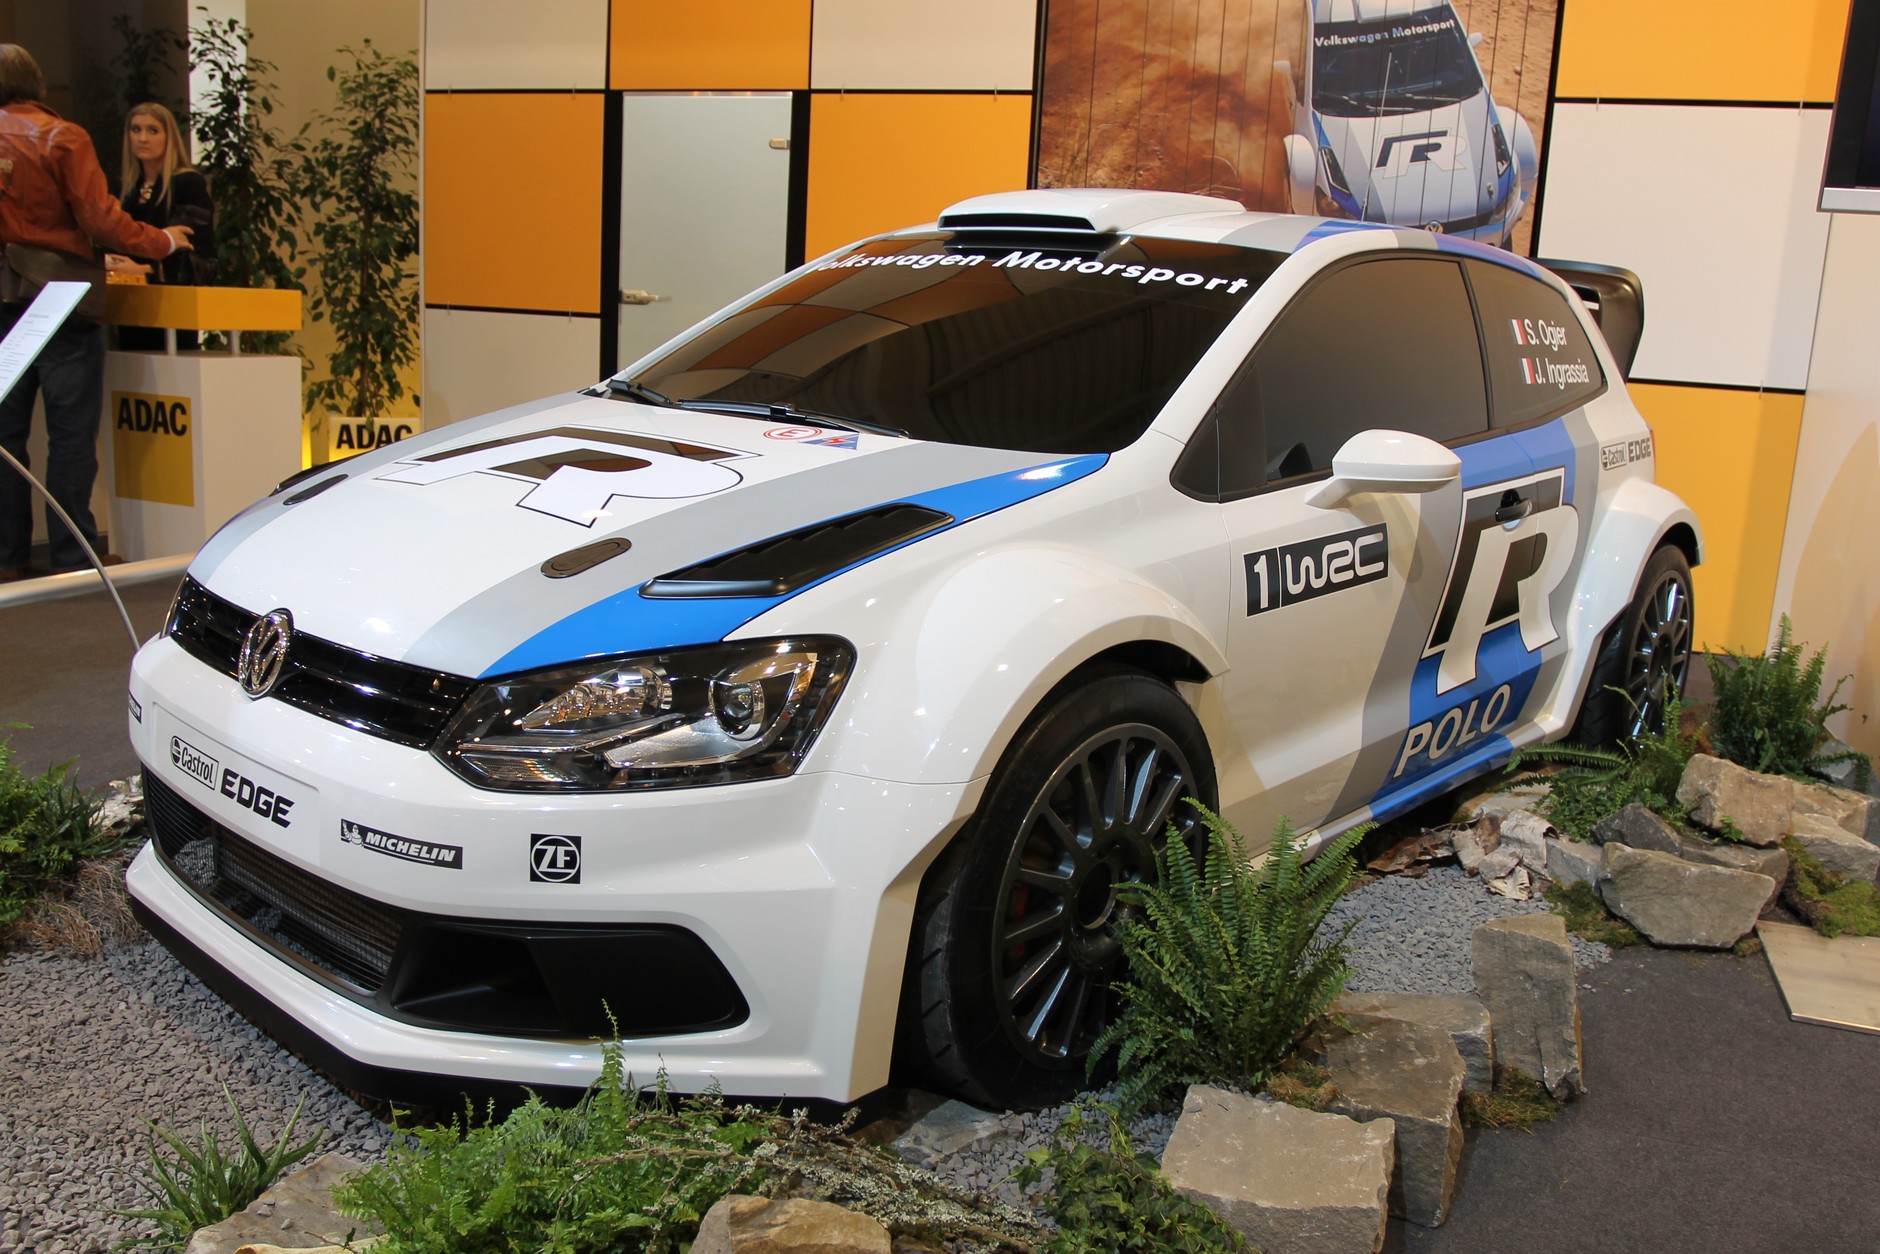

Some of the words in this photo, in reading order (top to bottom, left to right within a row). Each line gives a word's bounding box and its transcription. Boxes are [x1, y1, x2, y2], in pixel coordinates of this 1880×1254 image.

[1315, 31, 1389, 47] Volkswagen
[1392, 19, 1455, 39] Motorsport
[992, 251, 1248, 294] Motorsport
[1524, 319, 1539, 346] S.
[1538, 319, 1567, 352] Ogier
[1536, 358, 1546, 385] J.
[1545, 357, 1589, 390] Ingrassia
[117, 396, 187, 436] ADAC
[1607, 446, 1626, 467] Castrol
[1628, 437, 1652, 463] EDGE
[1253, 554, 1269, 609] 1
[1285, 532, 1385, 595] WRC
[1393, 684, 1511, 778] POLO
[181, 746, 214, 784] Castrol
[220, 767, 295, 829] EDGE
[365, 831, 456, 862] MICHELIN
[536, 846, 577, 873] ZF
